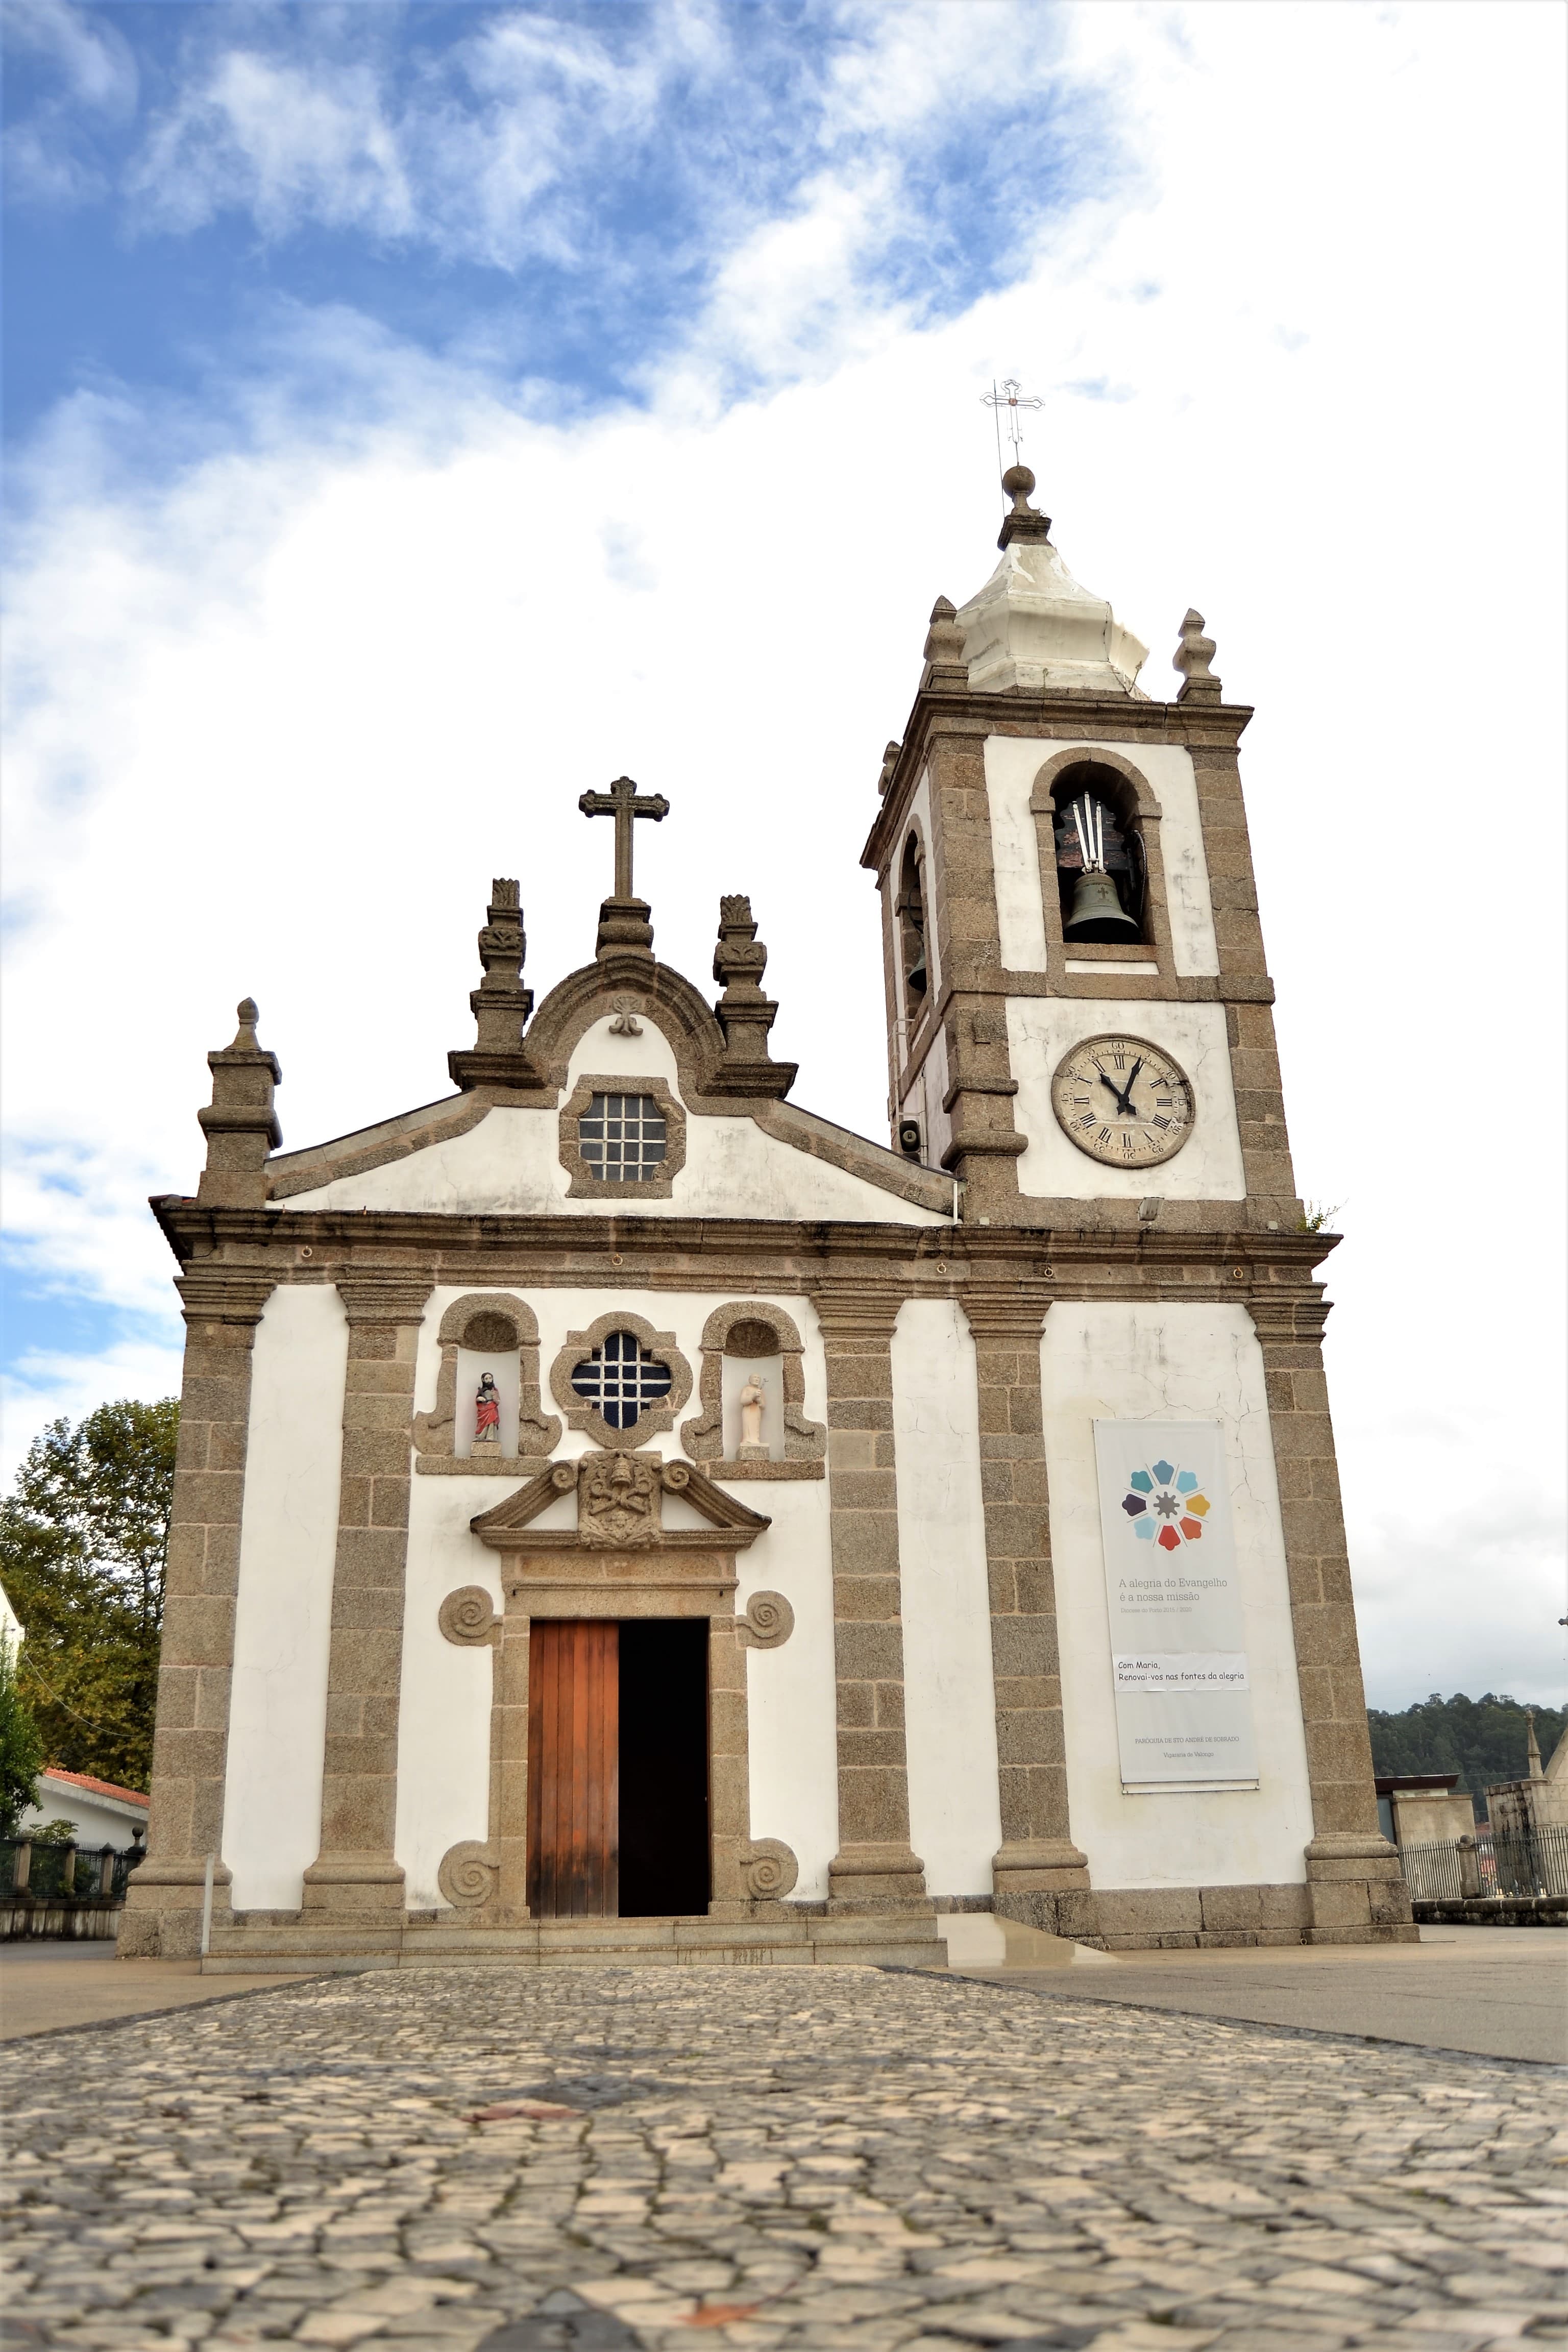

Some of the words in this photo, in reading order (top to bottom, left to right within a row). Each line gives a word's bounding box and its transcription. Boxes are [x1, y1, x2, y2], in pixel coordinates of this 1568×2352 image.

[1112, 1041, 1124, 1050] 60
[1113, 1055, 1125, 1070] XII
[1061, 1093, 1069, 1105] 45
[1156, 1097, 1172, 1107] III
[1122, 1133, 1132, 1148] VI
[1123, 1152, 1136, 1161] 30
[1119, 1578, 1126, 1587] A
[1129, 1578, 1161, 1589] alegria
[1164, 1578, 1176, 1587] do
[1179, 1578, 1228, 1588] Evangelho
[1120, 1592, 1125, 1601] é
[1166, 1591, 1199, 1601] missão
[1136, 1661, 1160, 1670] Maria,
[1181, 1672, 1206, 1680] fontes
[1219, 1672, 1244, 1681] alegria
